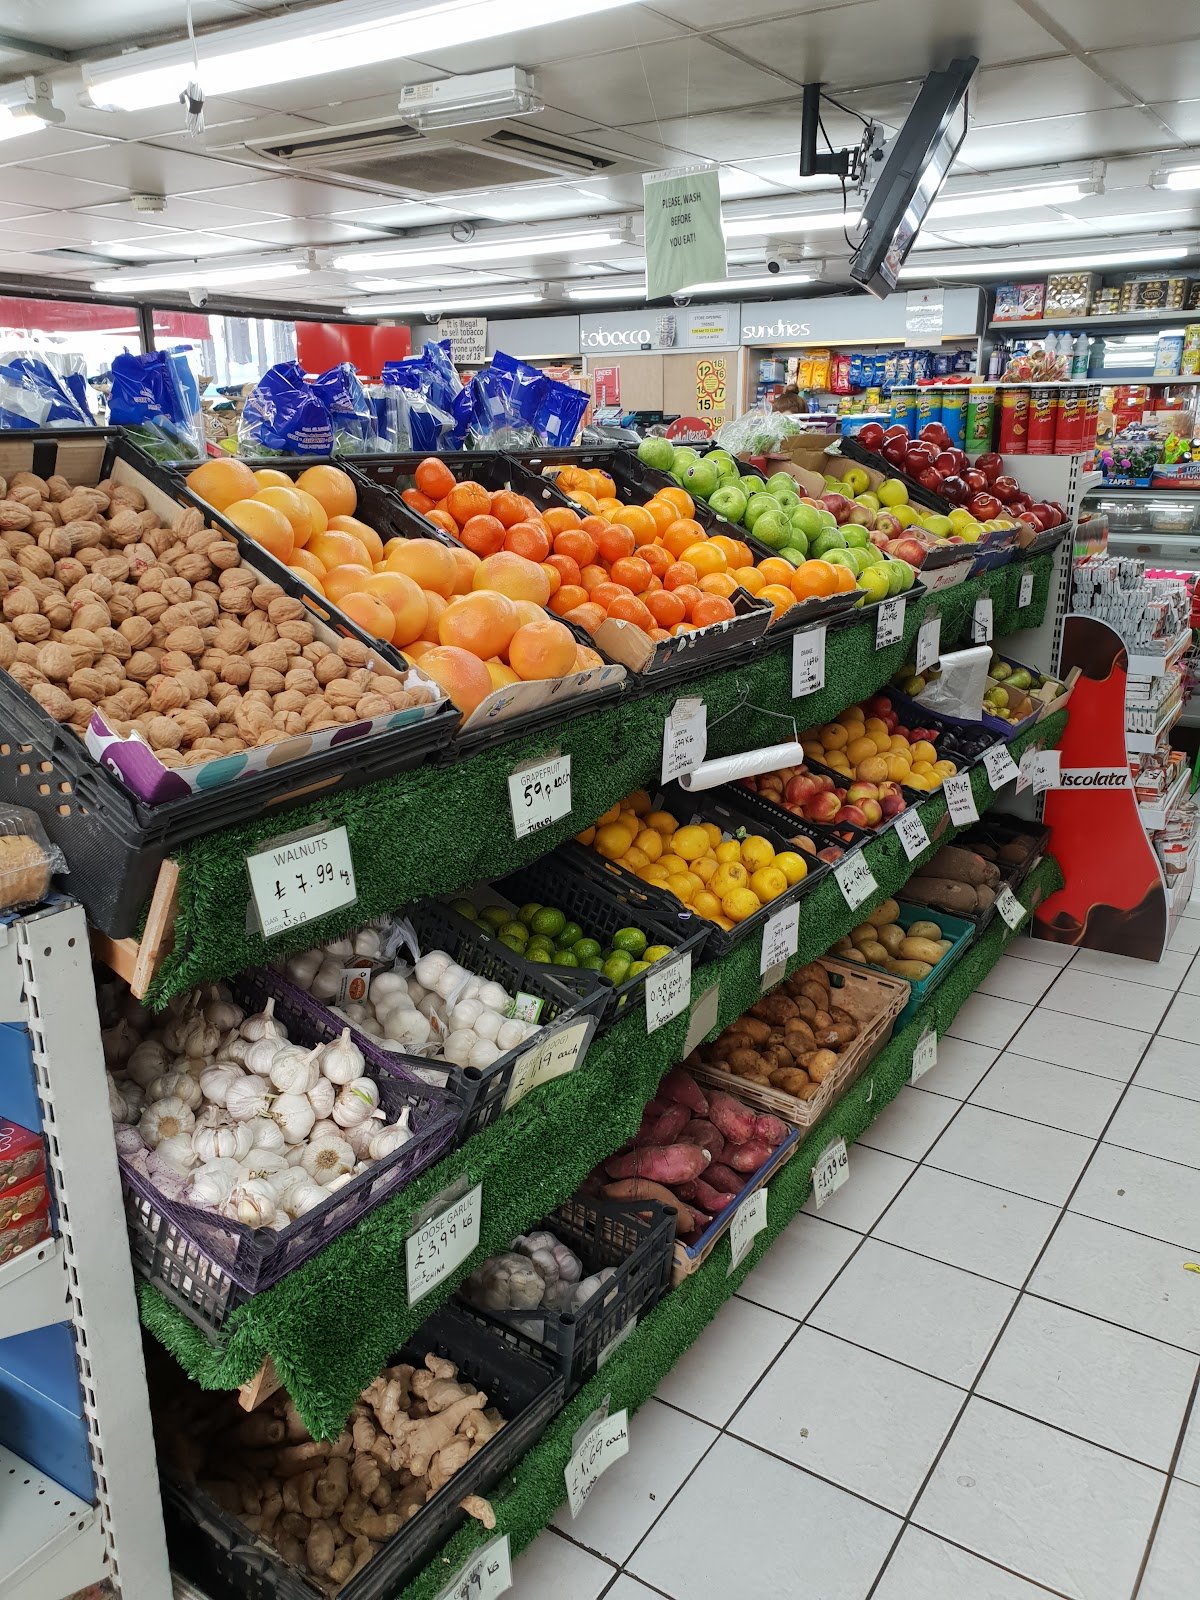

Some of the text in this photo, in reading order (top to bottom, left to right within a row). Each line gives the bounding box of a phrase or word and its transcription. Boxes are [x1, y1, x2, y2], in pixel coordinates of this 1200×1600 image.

[683, 192, 701, 204] WASH
[671, 213, 691, 226] BEFORE
[670, 232, 697, 247] YOU EAT!
[442, 328, 484, 337] to sell tobacco
[447, 320, 478, 329] It is illegal
[742, 319, 811, 340] sundries
[450, 337, 476, 345] products
[581, 327, 650, 347] tobacco
[469, 344, 486, 352] under
[454, 352, 481, 362] age of 18
[596, 369, 612, 377] UNDER
[699, 365, 711, 377] 12
[698, 399, 711, 410] 15
[1108, 478, 1135, 486] ZAPPER
[520, 762, 561, 786] GRAPEFRUIT
[273, 838, 328, 867] WALNUTS
[274, 880, 286, 900] £
[264, 916, 278, 927] CLASS
[266, 911, 307, 935] ORIGIN USA
[557, 1043, 578, 1060] each
[742, 1191, 761, 1212] POTATO
[417, 1195, 474, 1246] LOOSE GARLIC
[414, 1247, 425, 1270] £
[425, 1262, 445, 1283] CHINA
[579, 1427, 603, 1457] GARLIC
[605, 1428, 627, 1447] each
